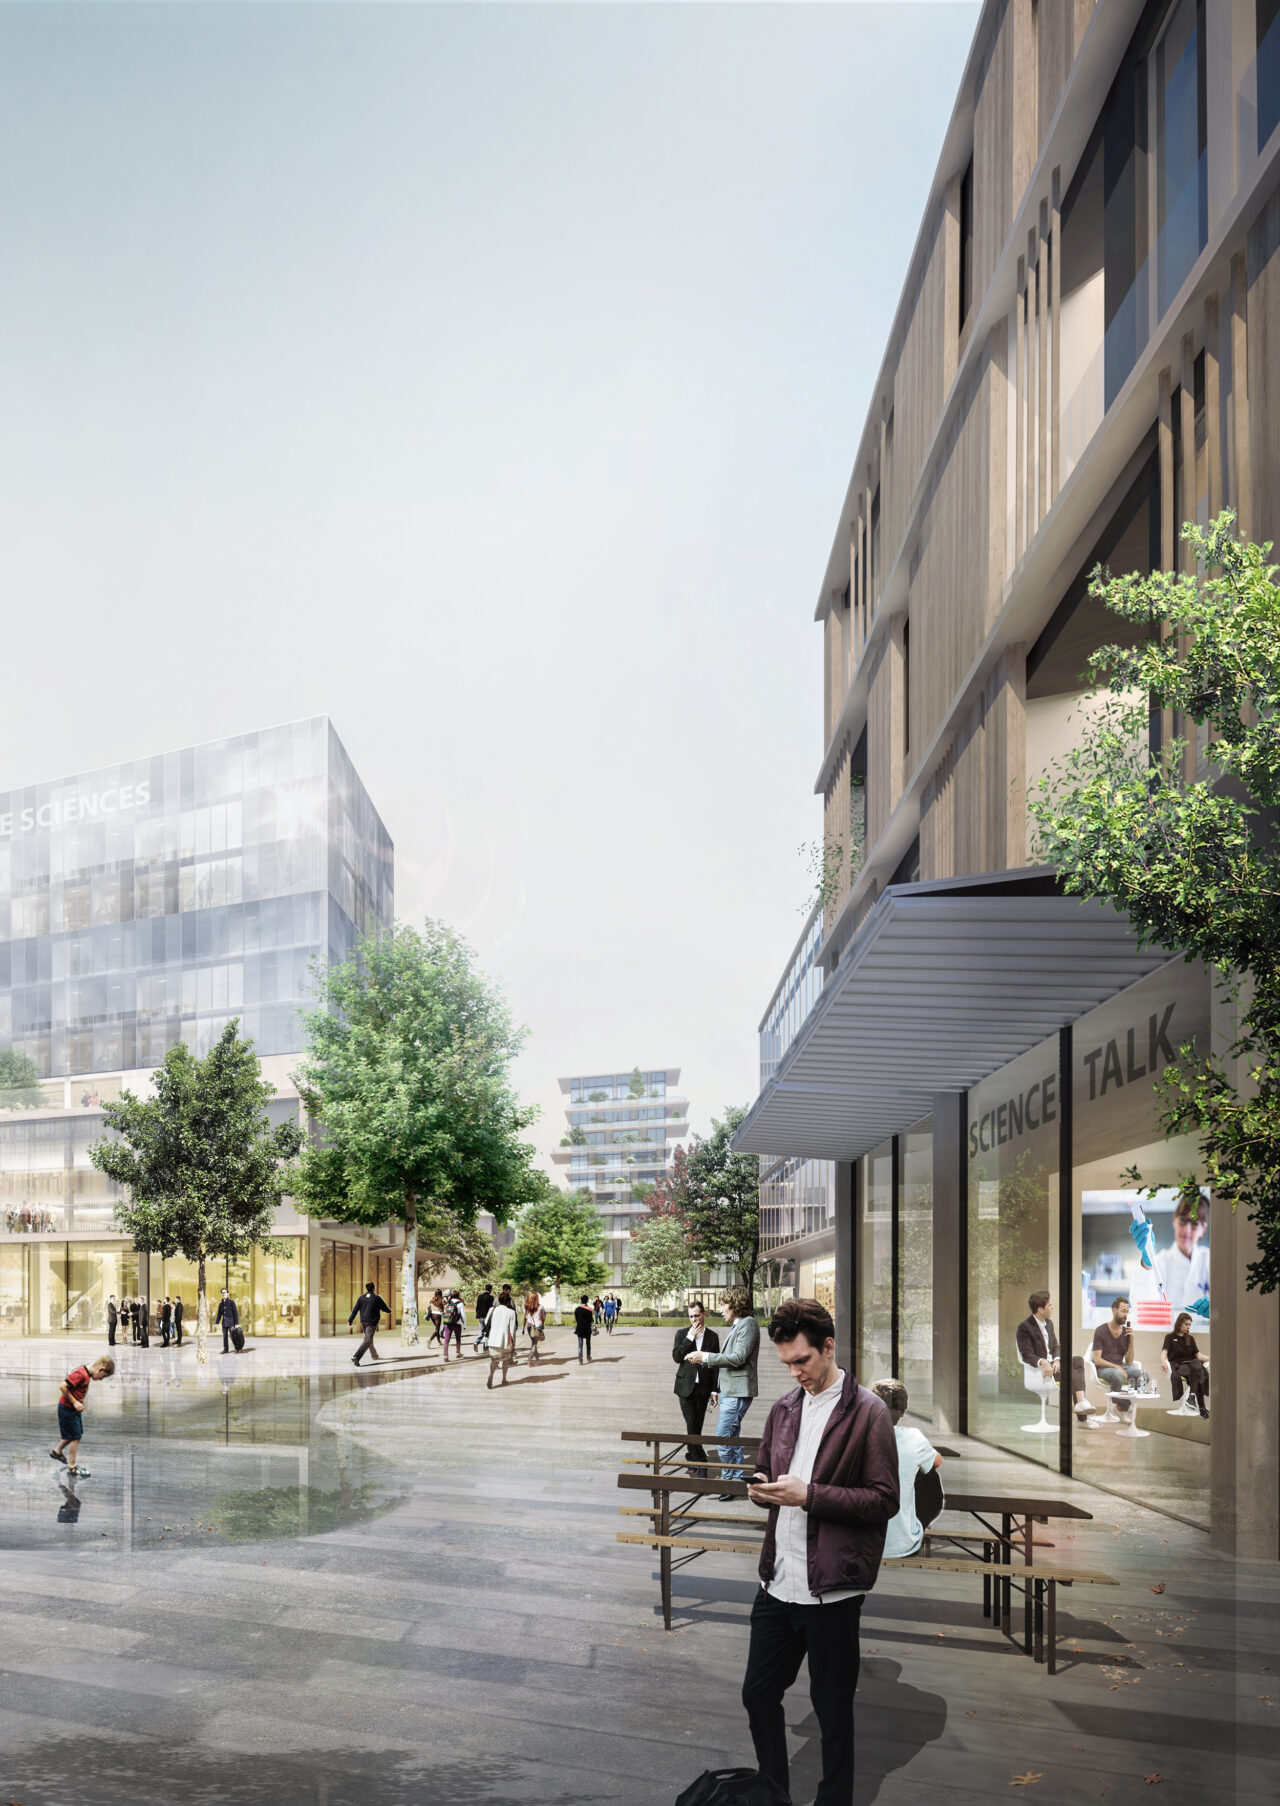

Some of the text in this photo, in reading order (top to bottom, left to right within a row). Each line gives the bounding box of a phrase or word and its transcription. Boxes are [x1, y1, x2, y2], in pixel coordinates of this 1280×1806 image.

[20, 780, 151, 832] SCIENCES
[969, 1001, 1177, 1159] SCIENCE TALK
